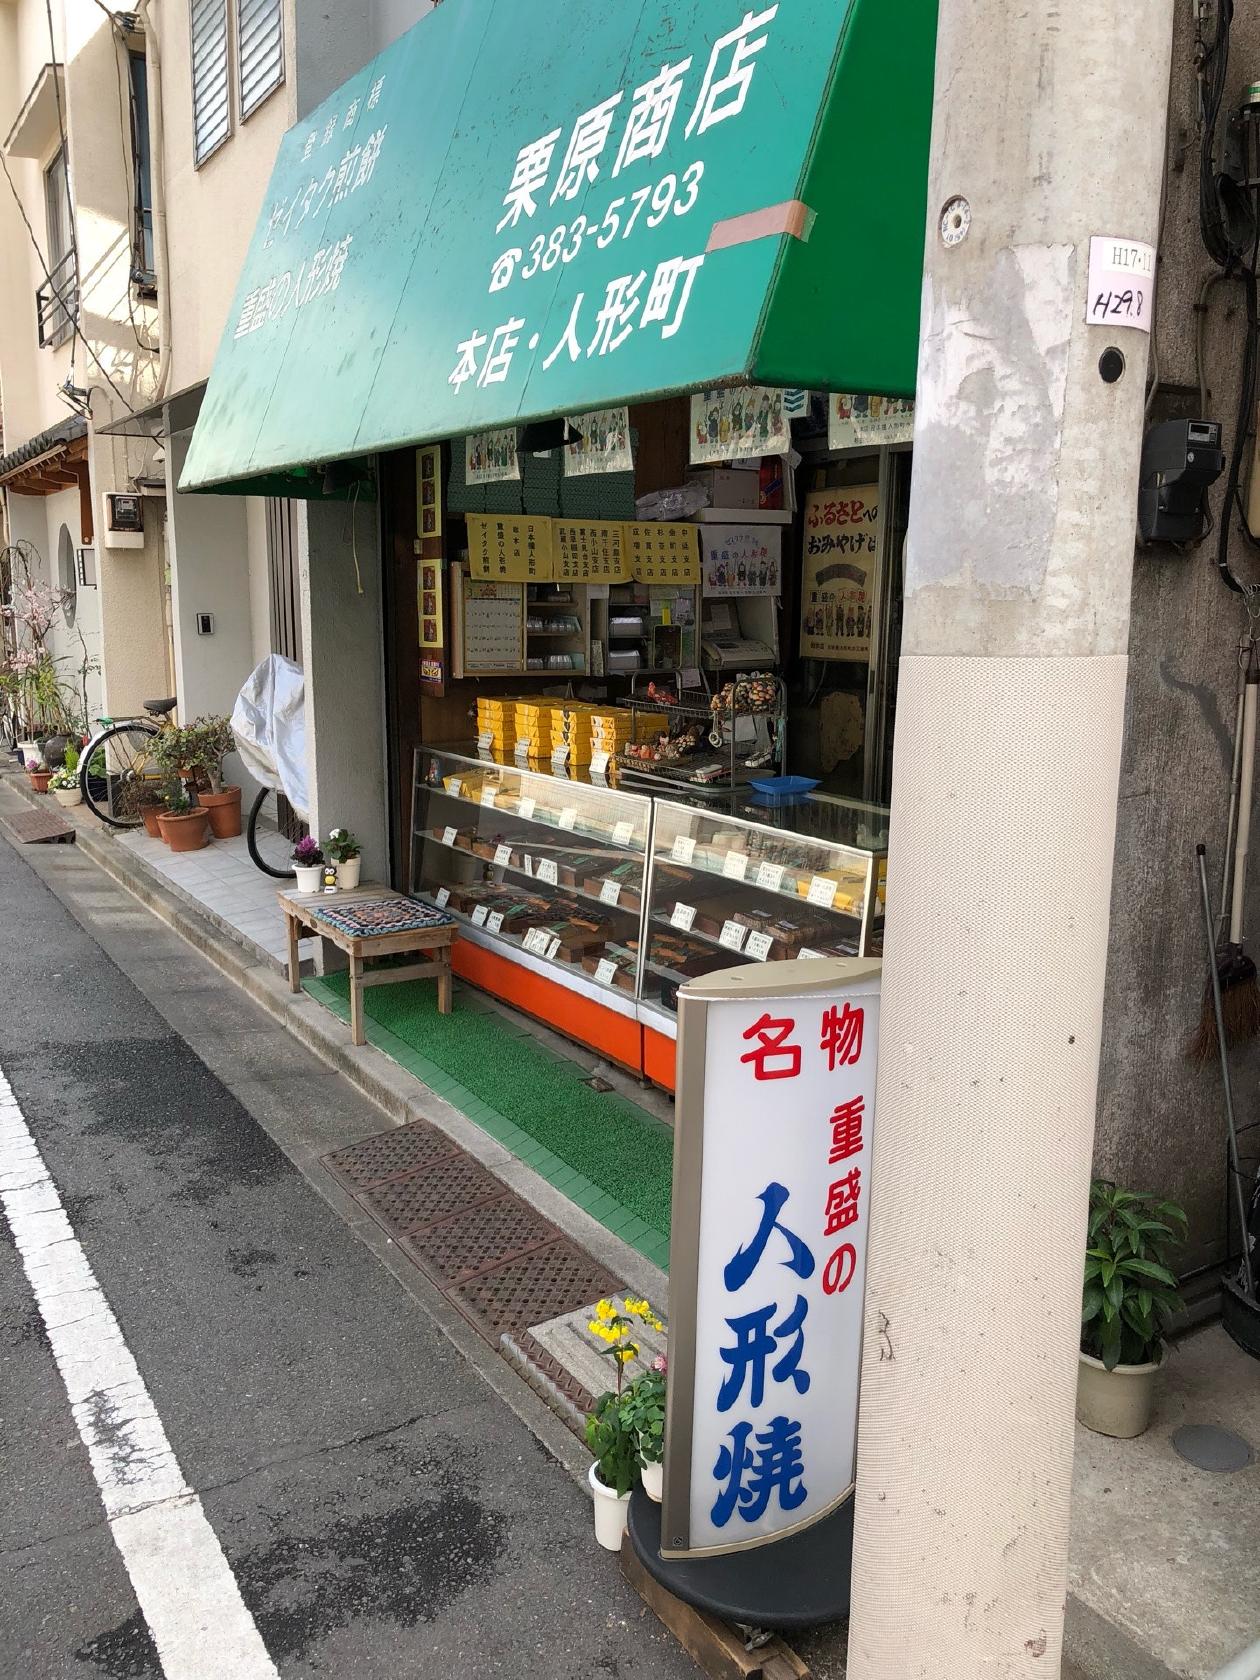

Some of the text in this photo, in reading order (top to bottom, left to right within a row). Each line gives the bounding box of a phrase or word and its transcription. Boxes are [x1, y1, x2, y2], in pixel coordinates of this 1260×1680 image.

[496, 3, 780, 235] 栗原商店
[522, 160, 705, 281] 383-5793
[821, 1094, 866, 1296] 重盛の
